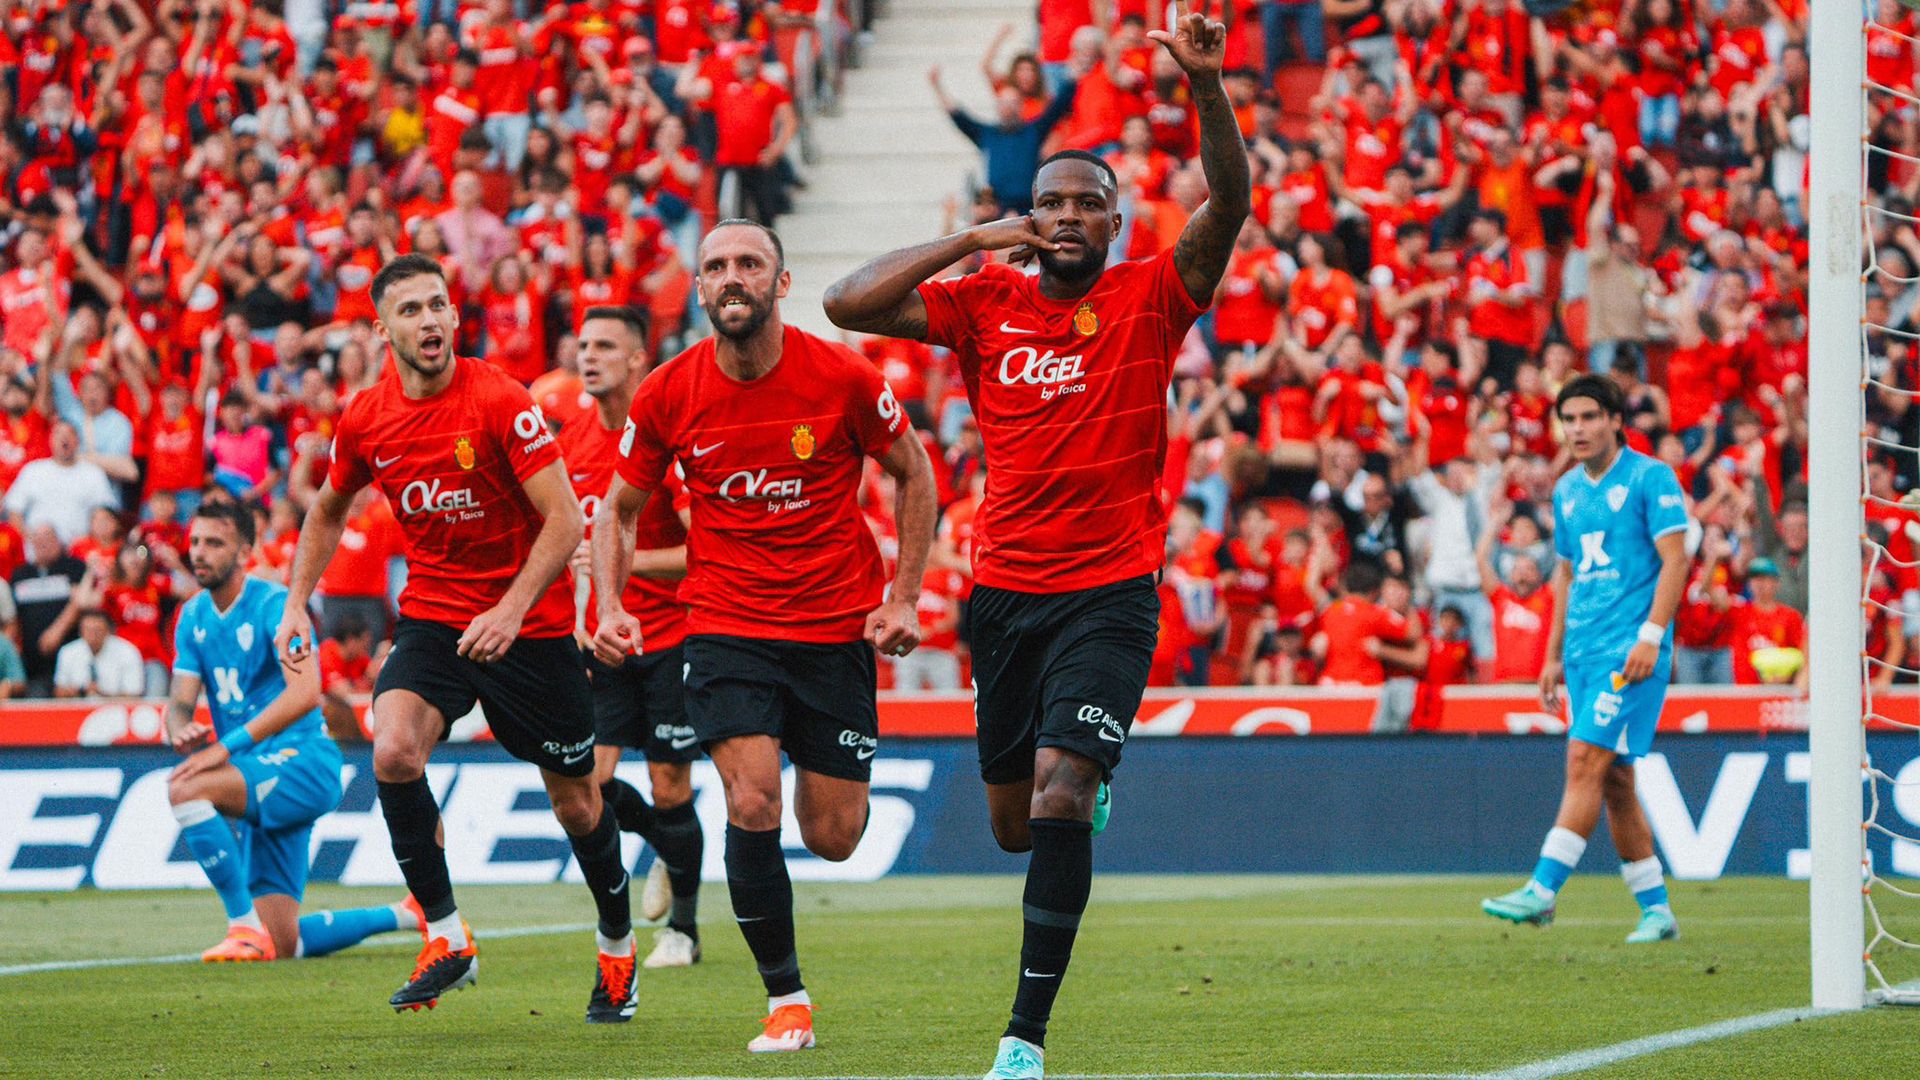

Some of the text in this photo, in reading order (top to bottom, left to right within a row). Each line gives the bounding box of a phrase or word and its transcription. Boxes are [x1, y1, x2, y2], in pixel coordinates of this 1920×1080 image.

[1041, 383, 1087, 401] by Taica
[767, 501, 781, 513] by
[445, 510, 484, 524] by Taica
